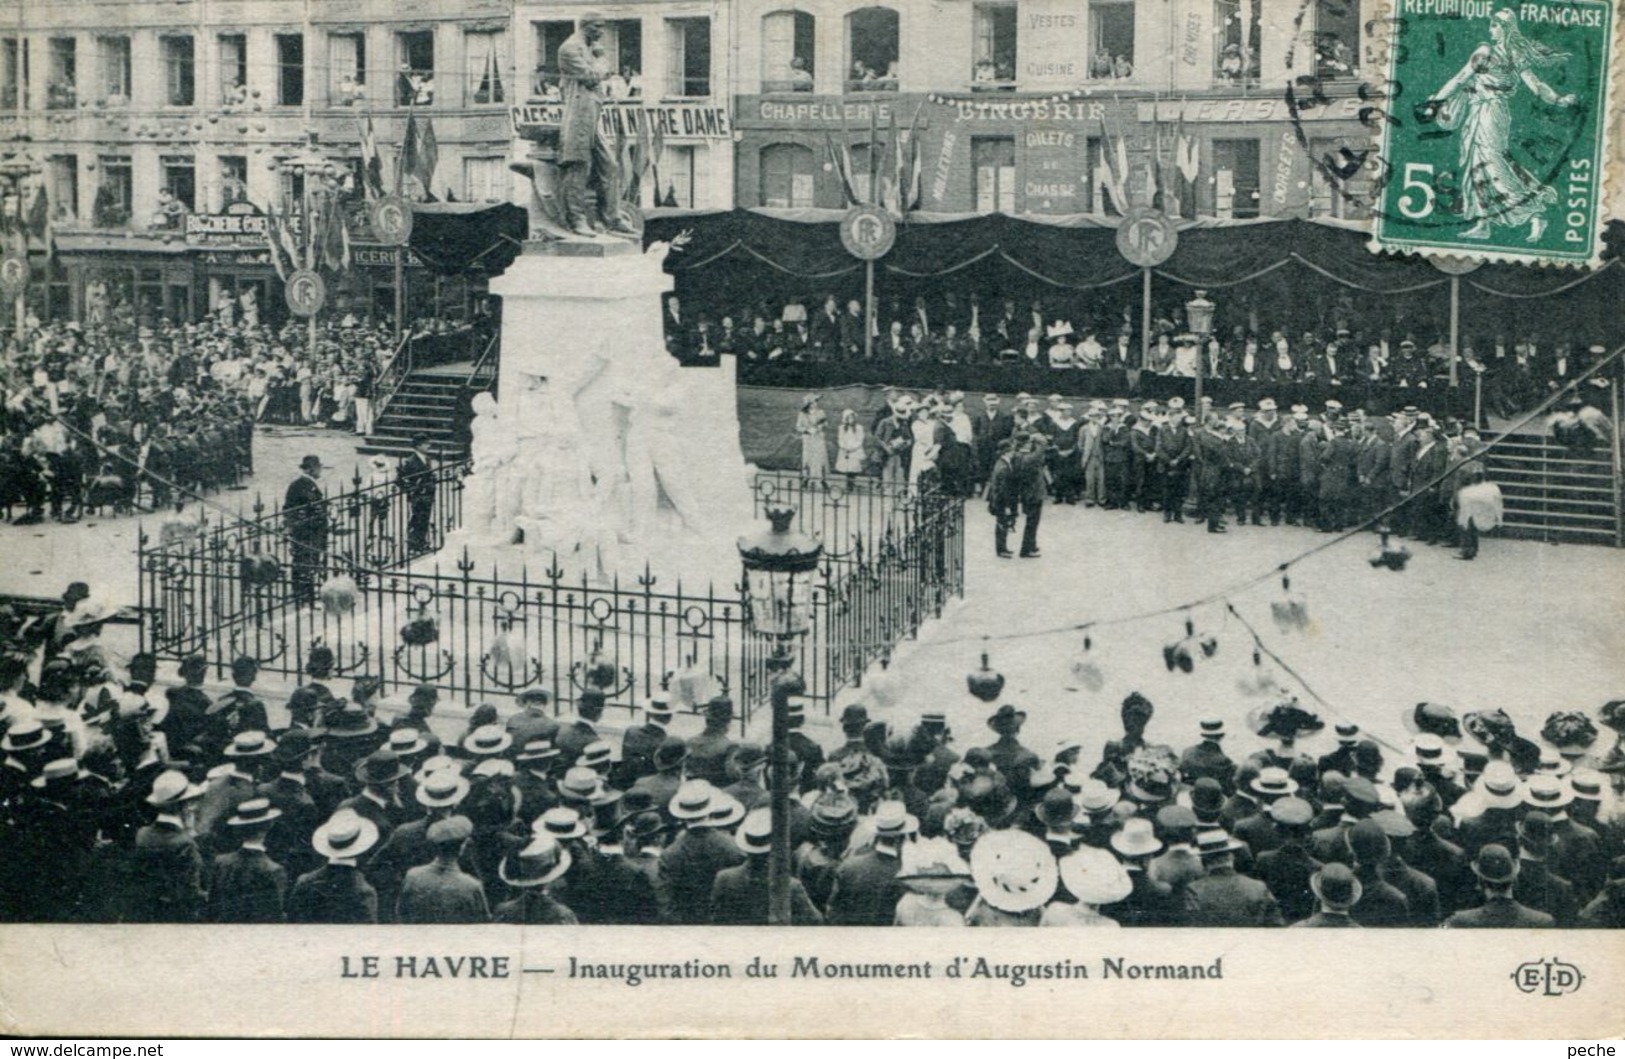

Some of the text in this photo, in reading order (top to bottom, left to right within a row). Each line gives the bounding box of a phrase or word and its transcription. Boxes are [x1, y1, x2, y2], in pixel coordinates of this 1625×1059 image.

[1030, 13, 1078, 29] VESTES
[1027, 62, 1075, 77] CUISINE
[626, 108, 678, 135] NOTRE
[682, 108, 728, 135] DAME
[1026, 131, 1075, 148] GILETS
[1024, 182, 1077, 197] CHASSE
[1564, 158, 1592, 243] POSTES
